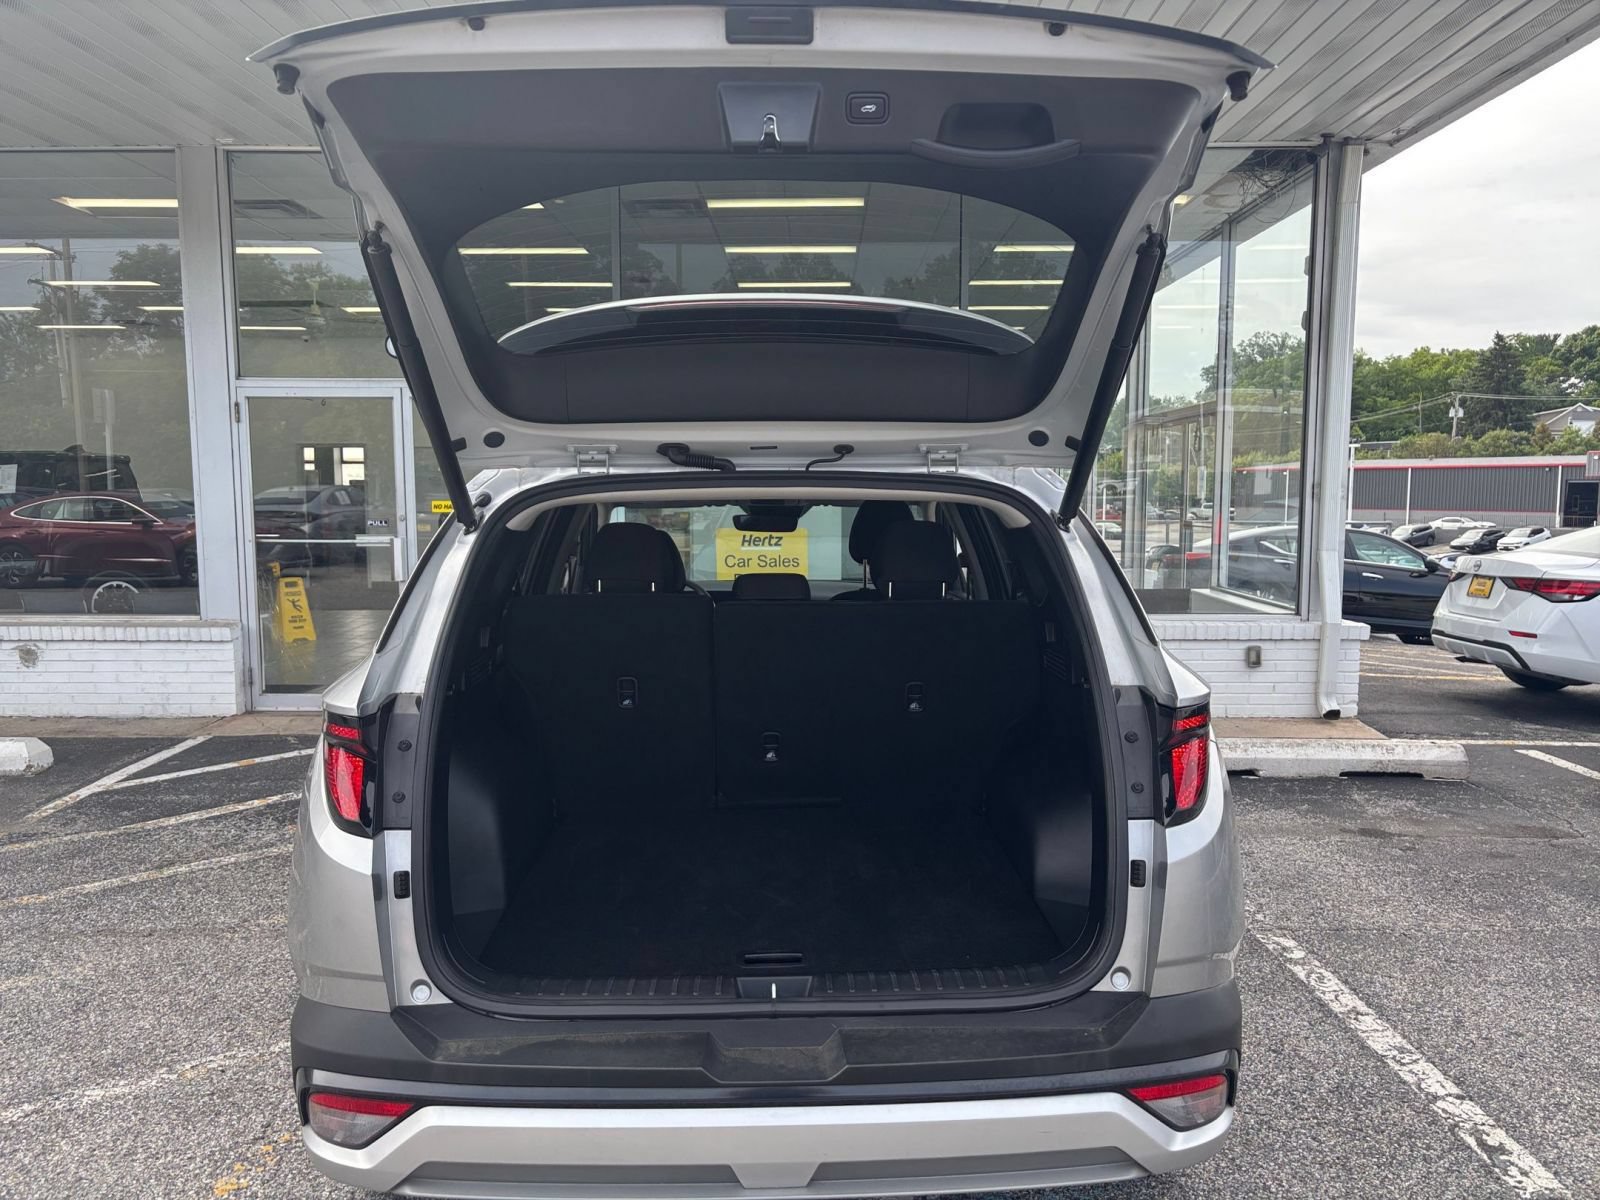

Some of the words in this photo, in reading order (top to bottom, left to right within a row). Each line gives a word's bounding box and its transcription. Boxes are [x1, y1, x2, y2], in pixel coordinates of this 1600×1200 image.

[741, 534, 783, 547] Hertz
[724, 554, 752, 568] Car
[757, 554, 800, 568] Sales
